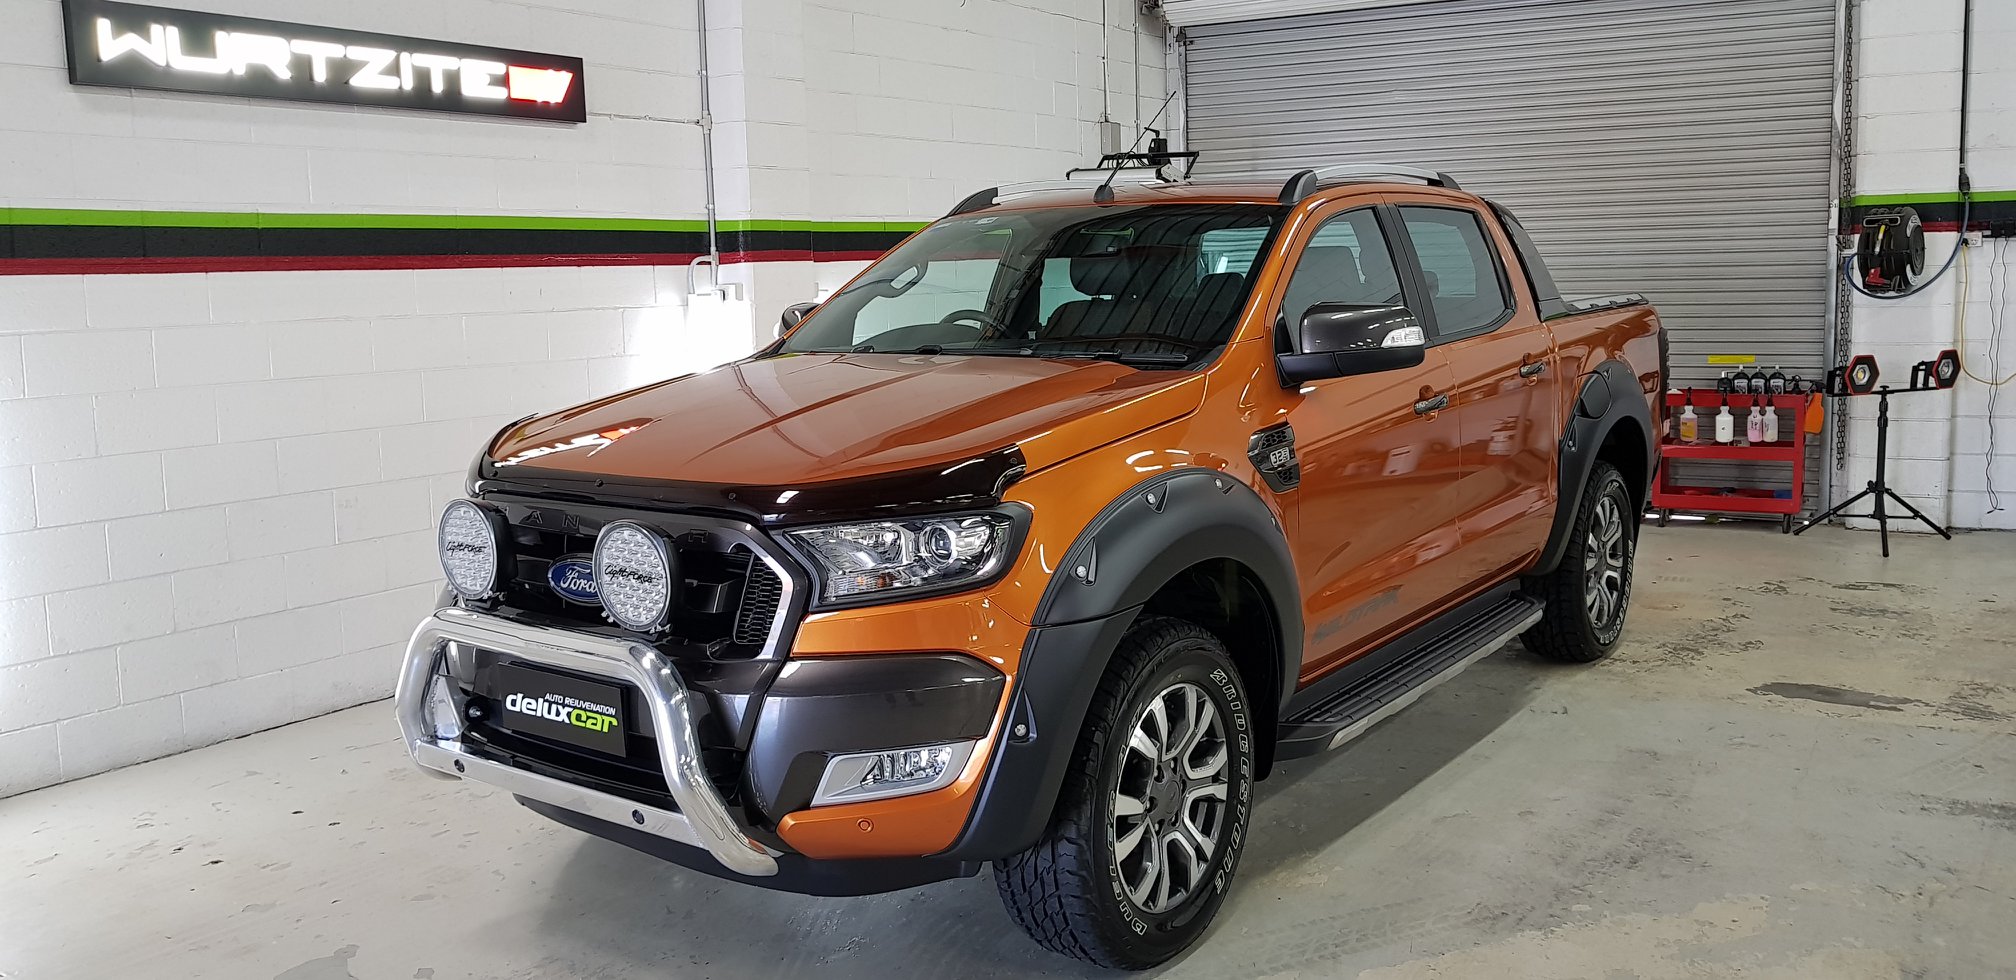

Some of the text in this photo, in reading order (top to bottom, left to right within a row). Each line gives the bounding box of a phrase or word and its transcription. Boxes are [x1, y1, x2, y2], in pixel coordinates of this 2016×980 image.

[97, 18, 508, 99] WURTZITE
[545, 692, 615, 715] AUTO REJUVENATION
[1209, 668, 1251, 895] BRIDGESTONE
